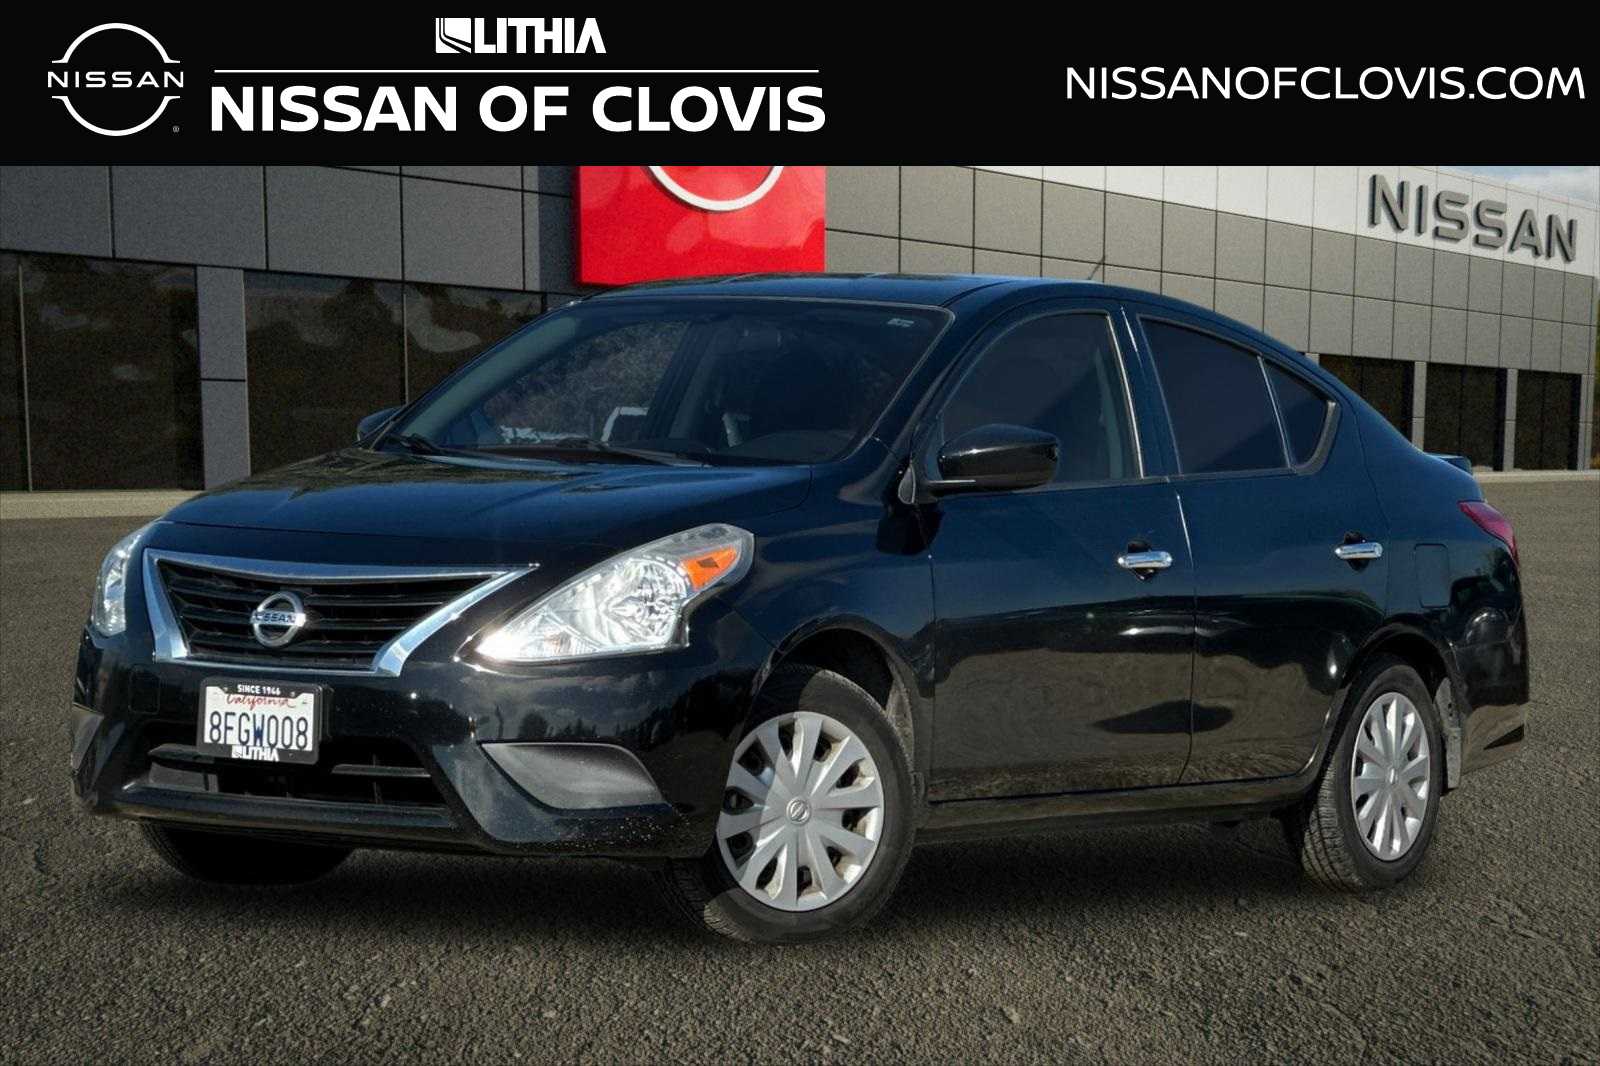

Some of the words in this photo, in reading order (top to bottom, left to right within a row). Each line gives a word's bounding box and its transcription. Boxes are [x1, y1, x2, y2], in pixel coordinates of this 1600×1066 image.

[1368, 174, 1578, 263] NISSAN
[237, 684, 261, 694] SINCE
[209, 710, 309, 750] 8FGW008
[243, 745, 280, 762] LITHIA
